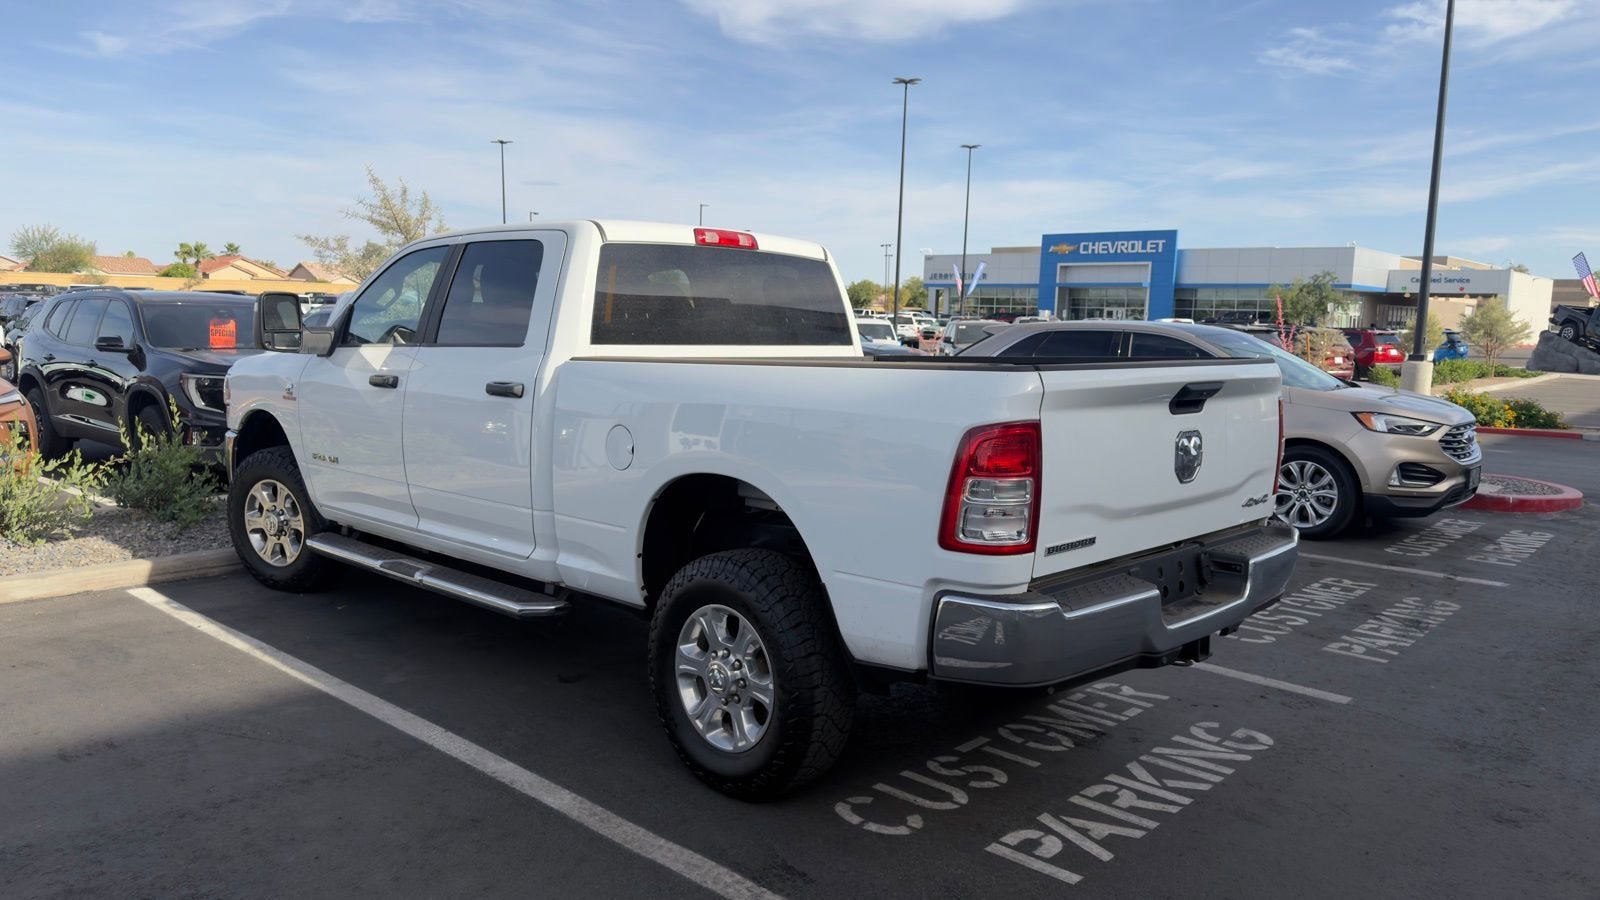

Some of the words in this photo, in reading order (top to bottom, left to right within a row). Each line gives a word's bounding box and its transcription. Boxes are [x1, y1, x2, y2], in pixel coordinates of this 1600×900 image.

[1080, 240, 1166, 254] CHEVROLET
[928, 272, 954, 280] JERRY
[1410, 276, 1442, 284] Ceied
[1443, 276, 1471, 284] Service
[1384, 518, 1486, 557] CUSTOMER
[1465, 529, 1555, 567] PARKING
[1321, 597, 1461, 663] PARKING
[834, 682, 1170, 836] CUSTOMER
[984, 721, 1274, 885] PARKING
